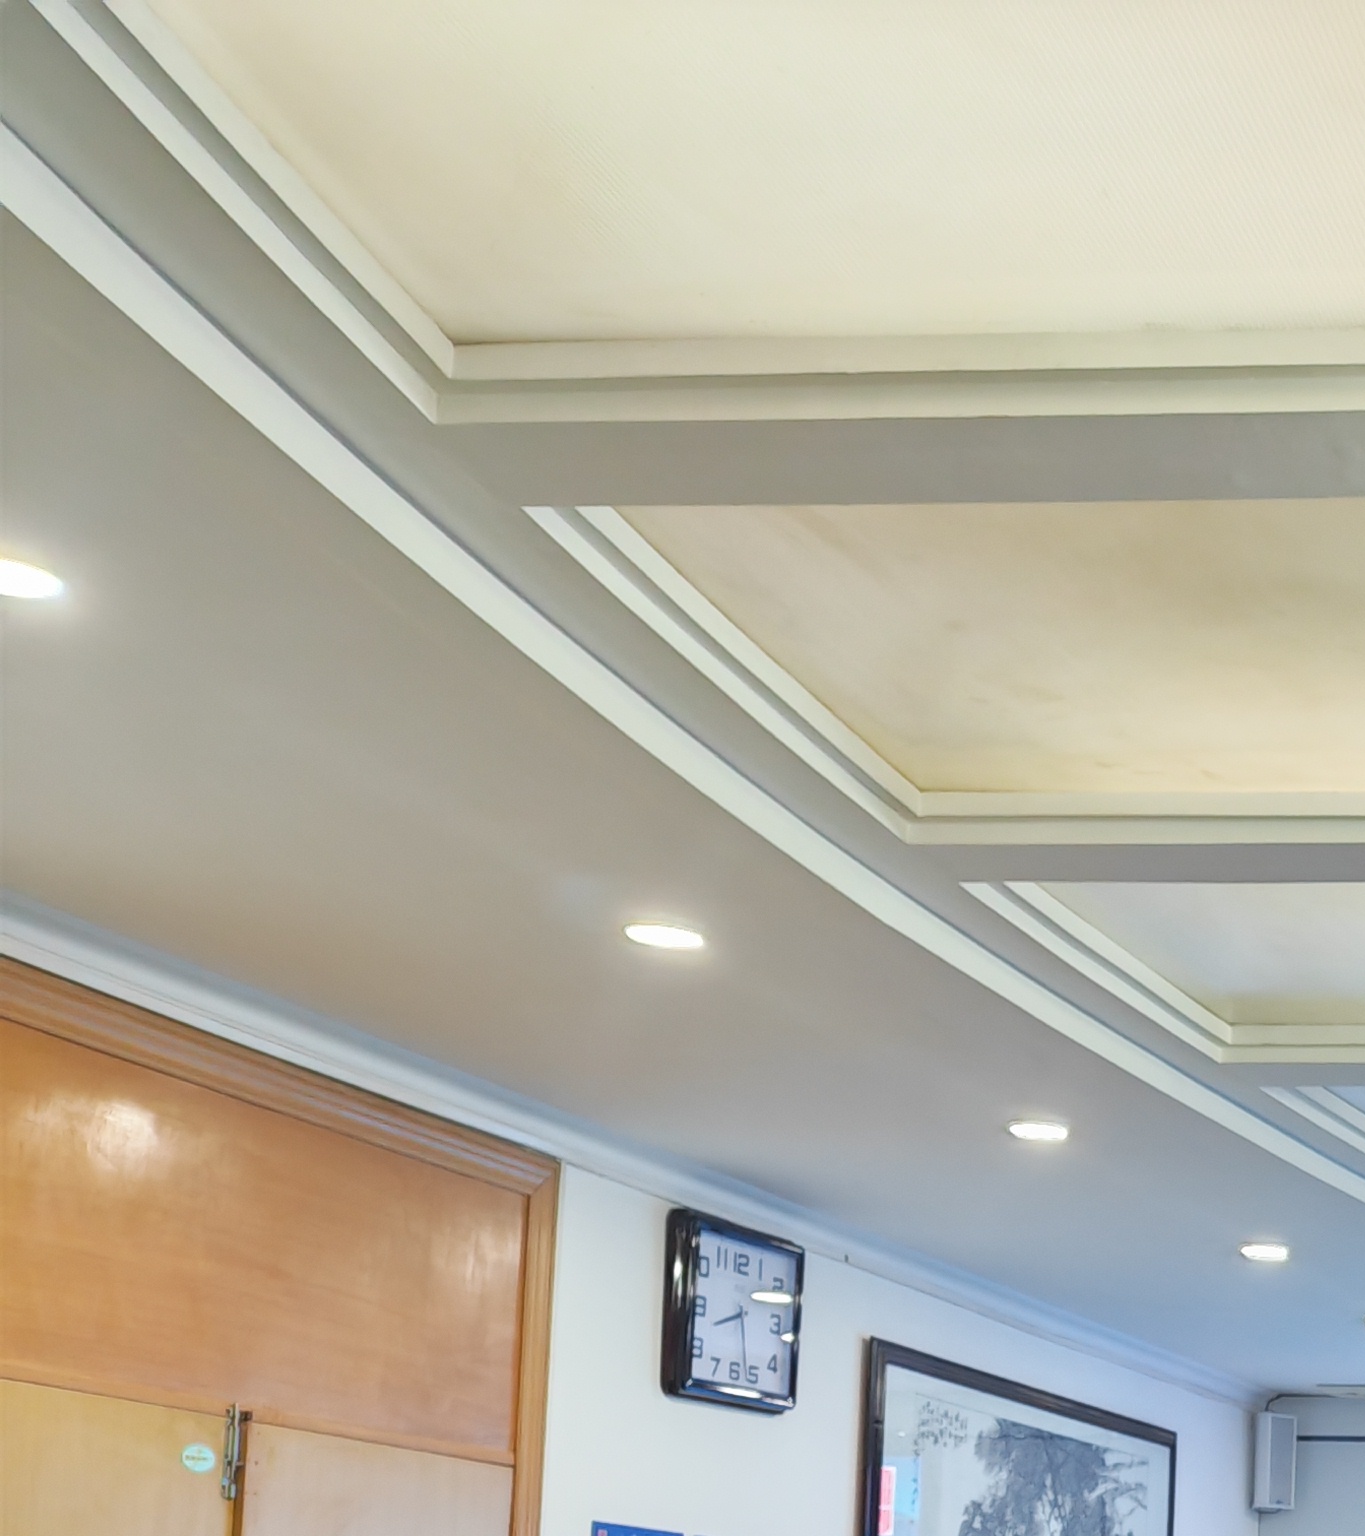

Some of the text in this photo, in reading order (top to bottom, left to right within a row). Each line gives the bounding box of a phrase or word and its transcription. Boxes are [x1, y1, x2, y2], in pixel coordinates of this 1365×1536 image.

[733, 1251, 750, 1276] 12
[769, 1313, 781, 1335] 3
[710, 1357, 721, 1377] 7
[728, 1361, 740, 1381] 6
[766, 1353, 778, 1374] 4
[748, 1365, 760, 1384] 5
